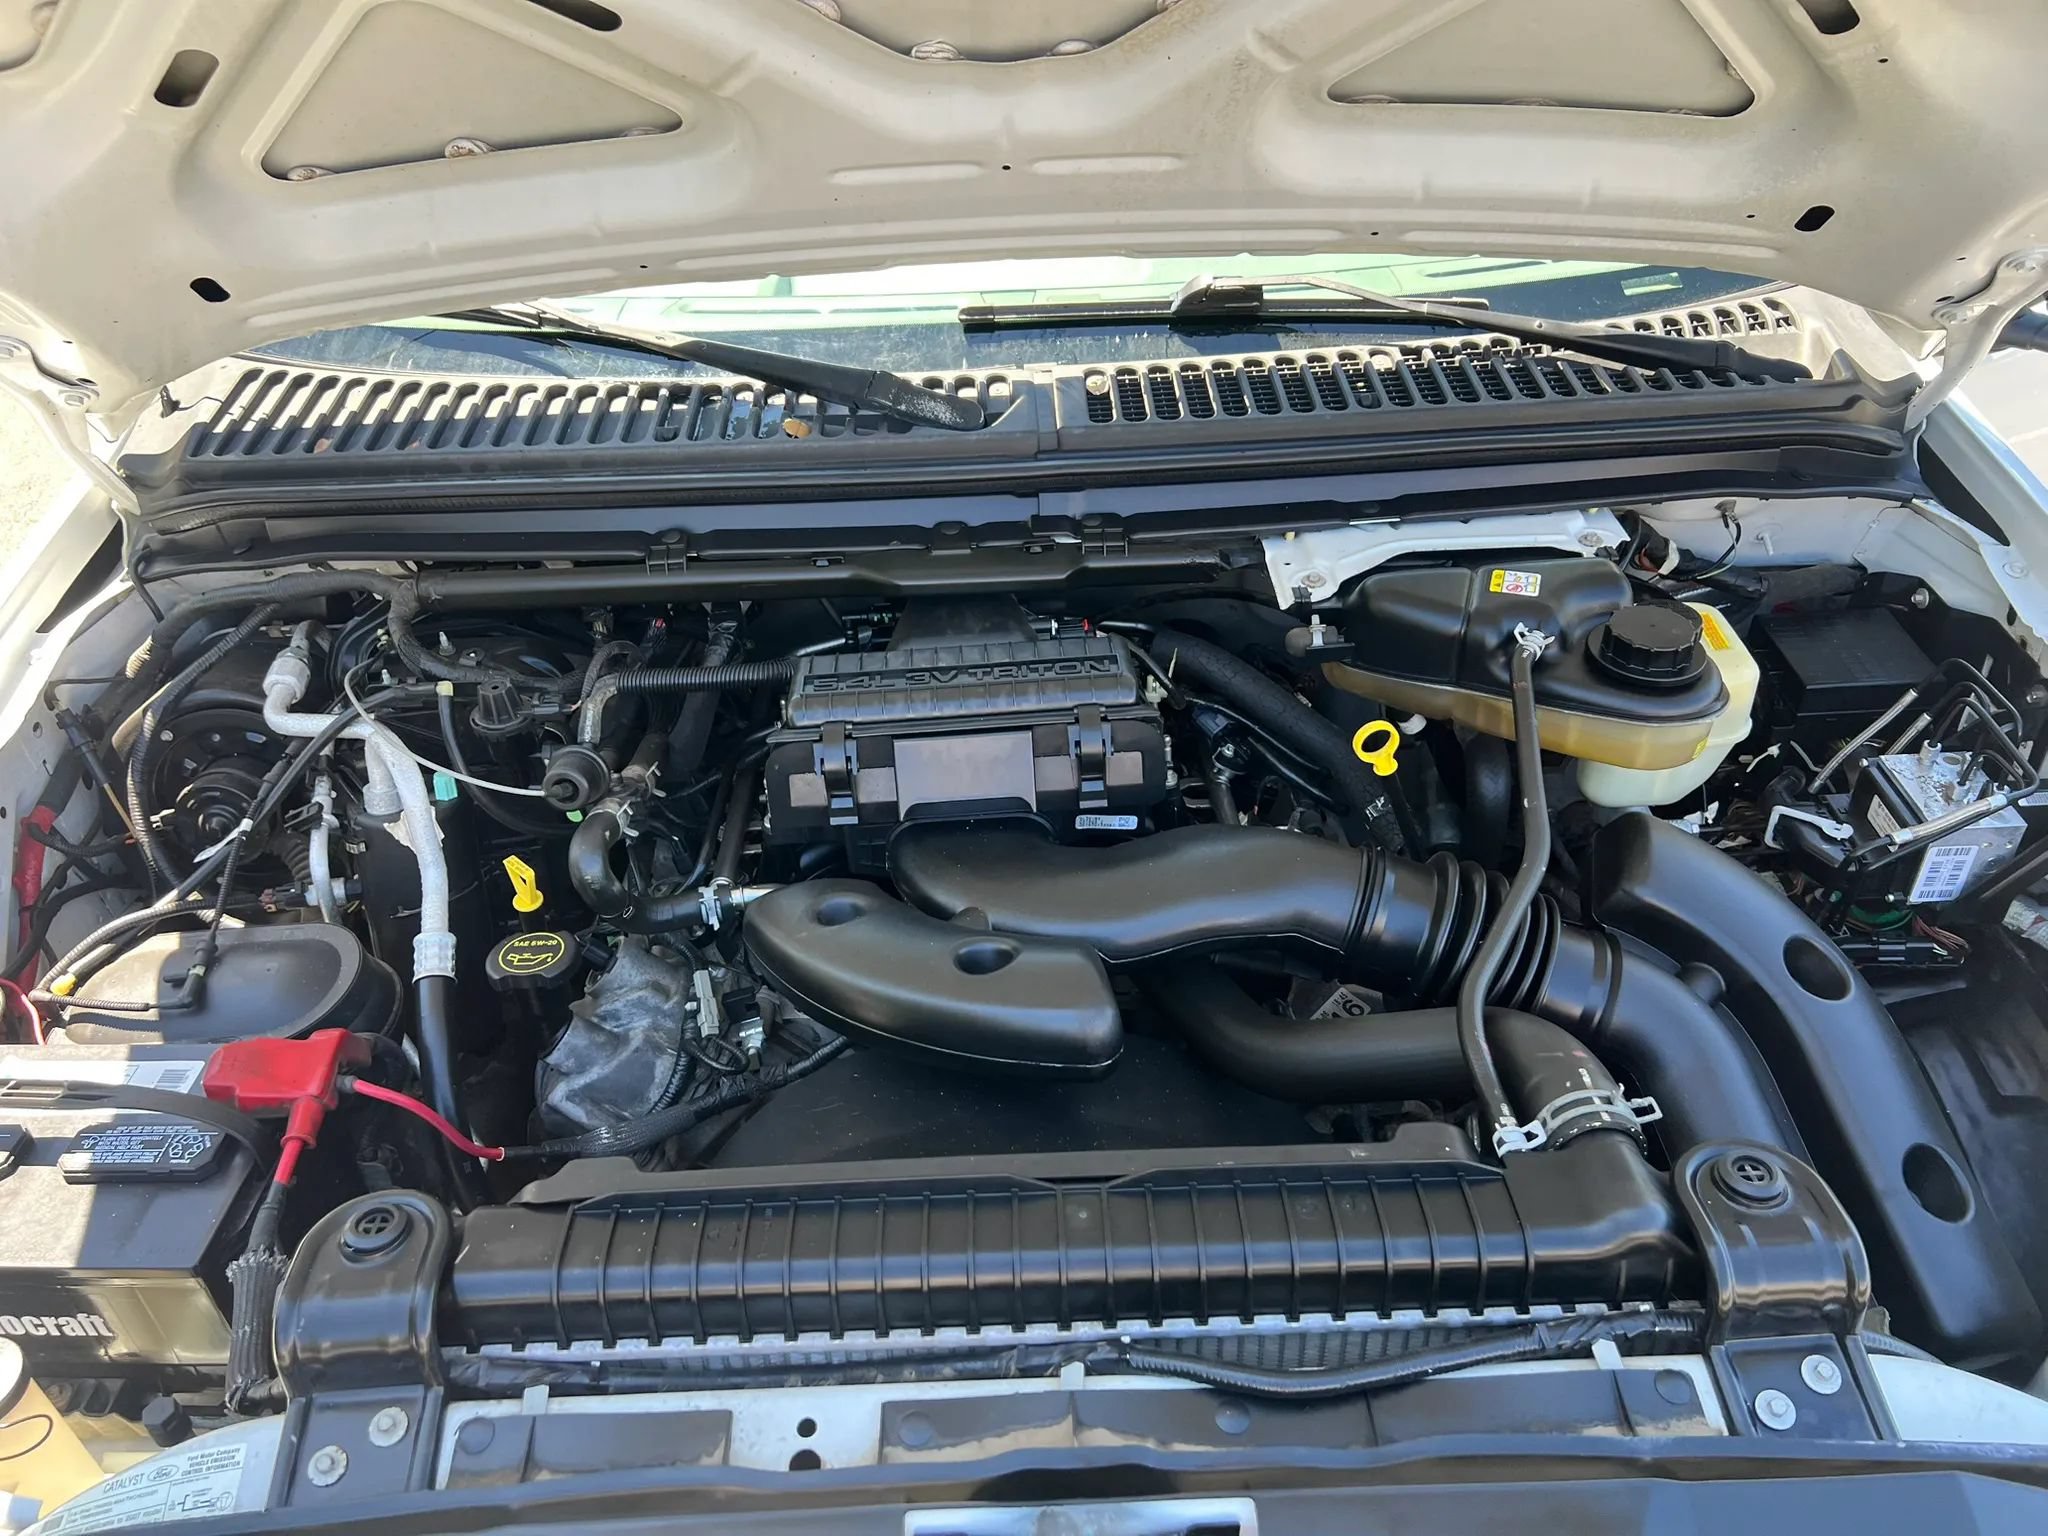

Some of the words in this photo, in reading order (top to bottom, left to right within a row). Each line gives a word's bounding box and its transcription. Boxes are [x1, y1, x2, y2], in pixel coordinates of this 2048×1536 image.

[812, 675, 896, 692] 5.4L
[905, 670, 958, 686] 3V
[968, 660, 1110, 682] TRITON
[0, 1313, 113, 1336] ocraft
[204, 1461, 241, 1473] INFORMATION
[103, 1473, 145, 1494] CATALYST
